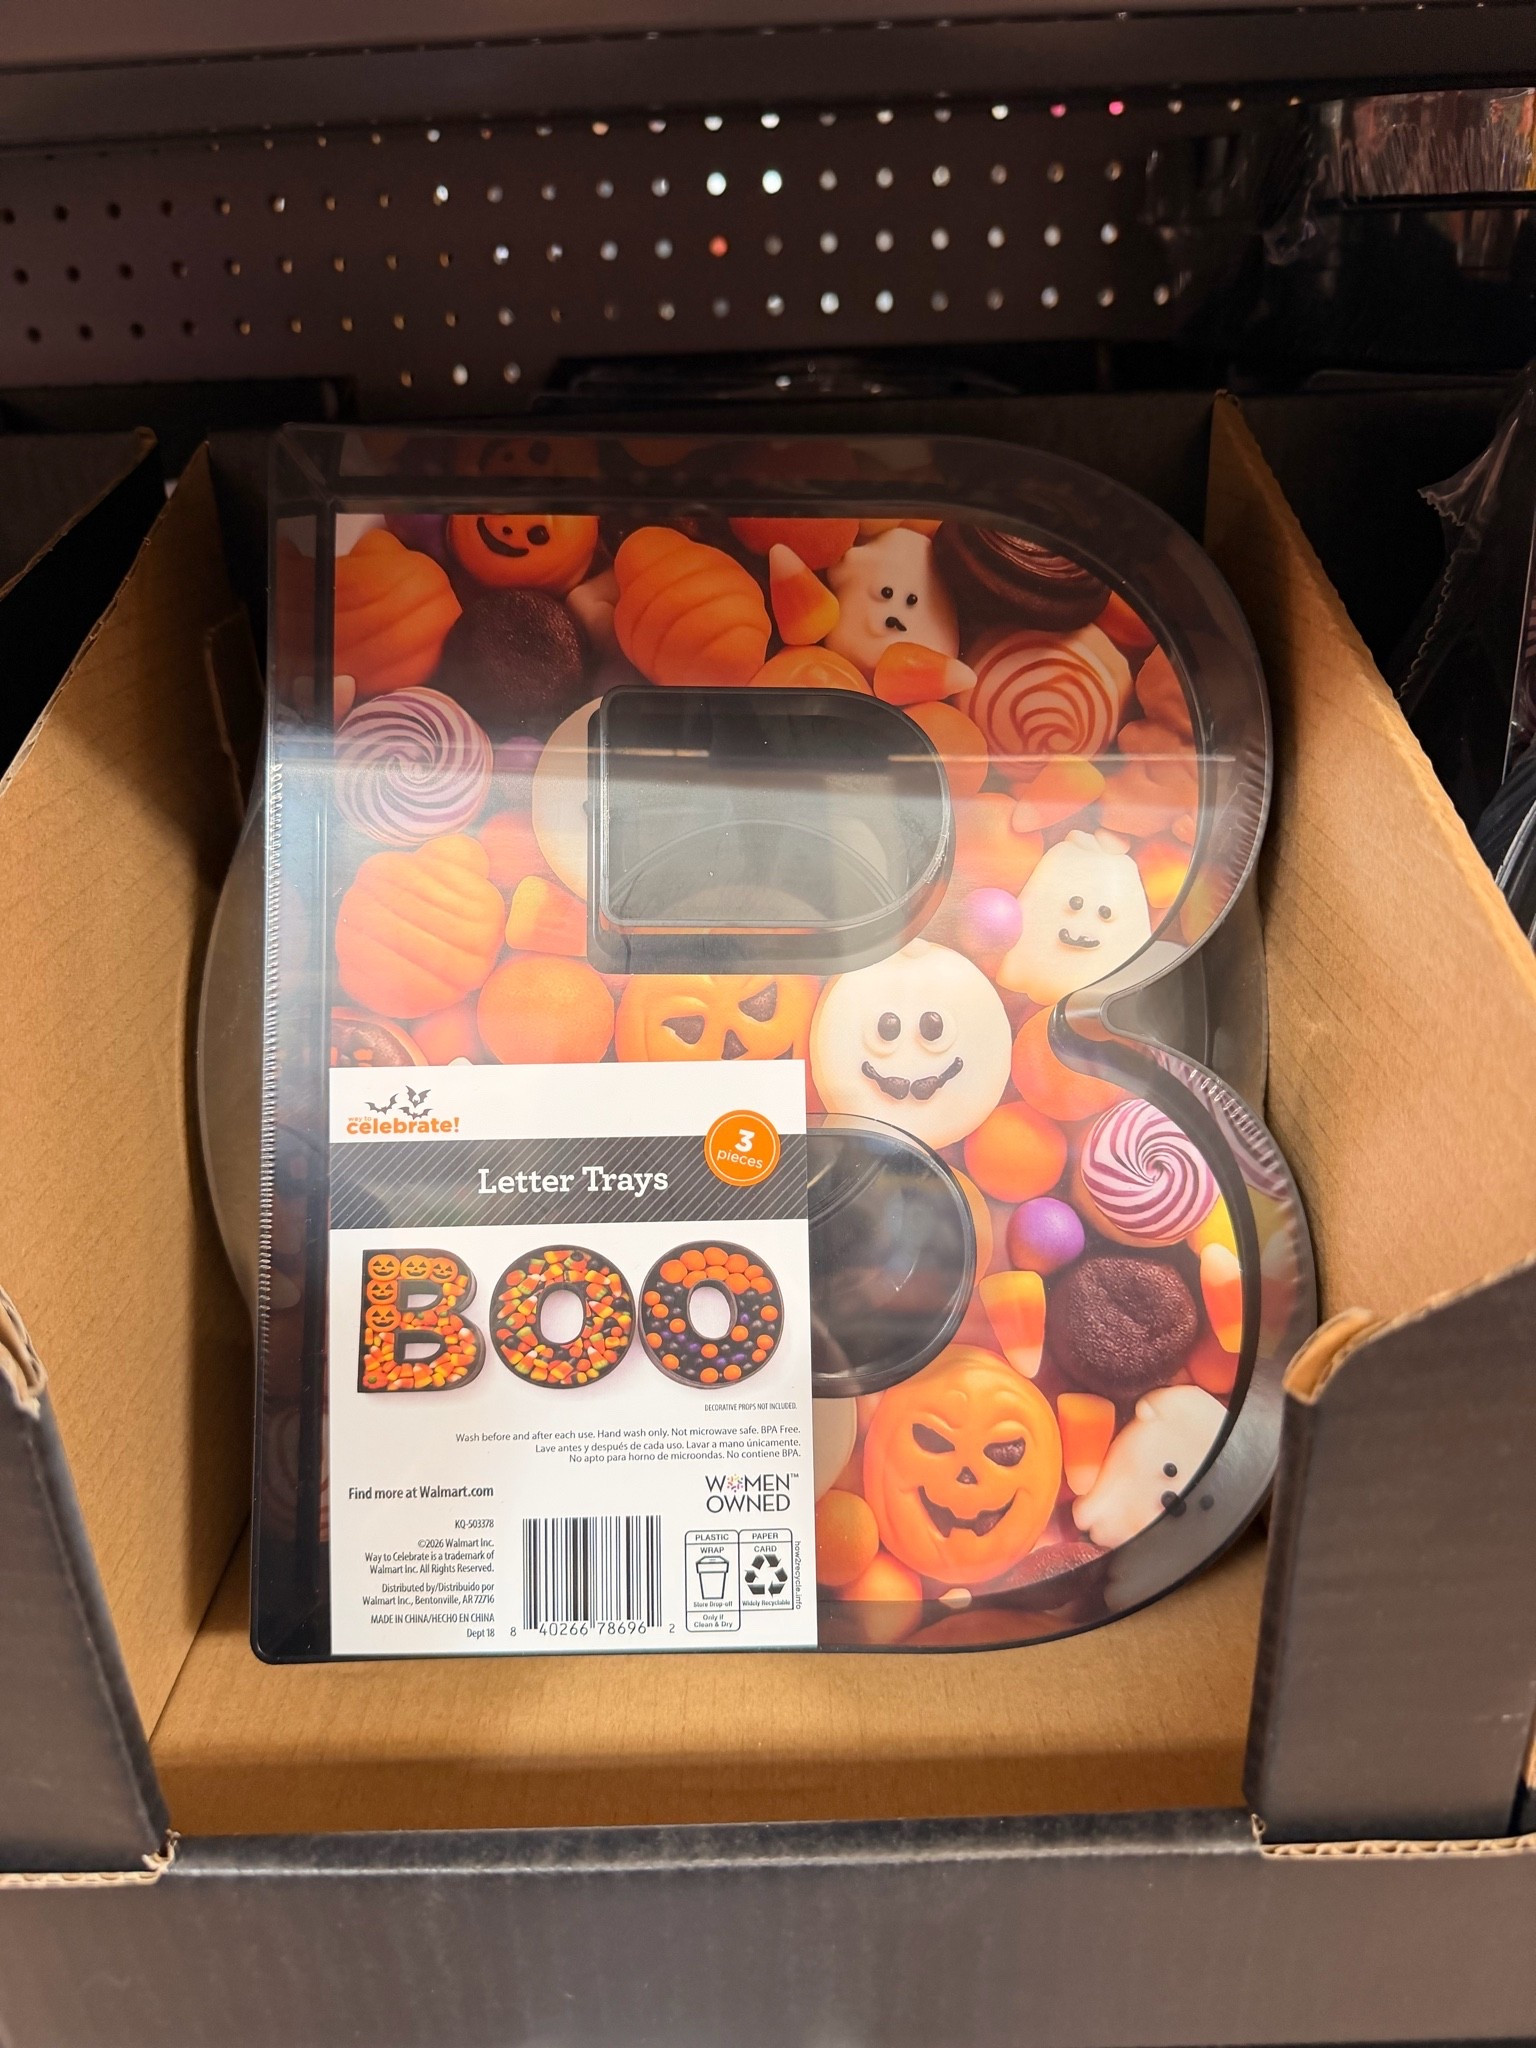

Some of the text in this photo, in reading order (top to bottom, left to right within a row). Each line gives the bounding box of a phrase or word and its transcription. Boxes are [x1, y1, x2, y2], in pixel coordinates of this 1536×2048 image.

[346, 1117, 460, 1134] celebrate!
[734, 1129, 756, 1152] 3
[716, 1149, 764, 1168] pieces
[478, 1166, 669, 1198] Letter Trays
[704, 1402, 798, 1412] DECORATIVE PROPS NOT INCLUDED.
[456, 1433, 480, 1442] Wash
[482, 1432, 511, 1442] before
[512, 1432, 530, 1441] and
[532, 1430, 552, 1440] after
[554, 1430, 576, 1440] each
[597, 1429, 621, 1438] Hand
[624, 1428, 646, 1438] wash
[648, 1428, 670, 1438] only.
[671, 1428, 688, 1436] Not
[690, 1426, 738, 1436] microwave
[740, 1426, 759, 1434] safe.
[760, 1426, 778, 1434] BPA
[780, 1425, 801, 1434] Free.
[535, 1444, 556, 1453] Lave
[558, 1444, 582, 1452] antes
[584, 1444, 589, 1454] y
[591, 1442, 628, 1454] después
[630, 1442, 642, 1450] de
[644, 1441, 665, 1450] cada
[666, 1442, 684, 1450] uso.
[686, 1440, 710, 1449] Lavar
[746, 1438, 801, 1448] únicamente.
[569, 1448, 801, 1464] No apto para horno de microondas. No contiene BPA.
[348, 1486, 494, 1500] Find more at Walmart.com
[706, 1494, 790, 1514] OWNED
[454, 1519, 494, 1529] KQ-503378
[418, 1538, 494, 1548] ©2026 Walmart Inc.
[364, 1552, 382, 1564] Way
[383, 1552, 392, 1562] to
[392, 1551, 430, 1562] Celebrate
[430, 1551, 437, 1561] is
[444, 1550, 485, 1560] trademark
[486, 1550, 495, 1560] of
[370, 1562, 494, 1576] Walmart Inc. All Rights Reserved.
[382, 1582, 494, 1594] Distributed by/Distribuido por
[362, 1594, 495, 1606] Walmart Inc., Bentonville, AR 72716
[370, 1613, 495, 1624] MADE IN CHINA/HECHO EN CHINA
[721, 1620, 733, 1628] Dry
[466, 1628, 495, 1640] Dept 18
[510, 1621, 676, 1636] 8 40266 78696 2
